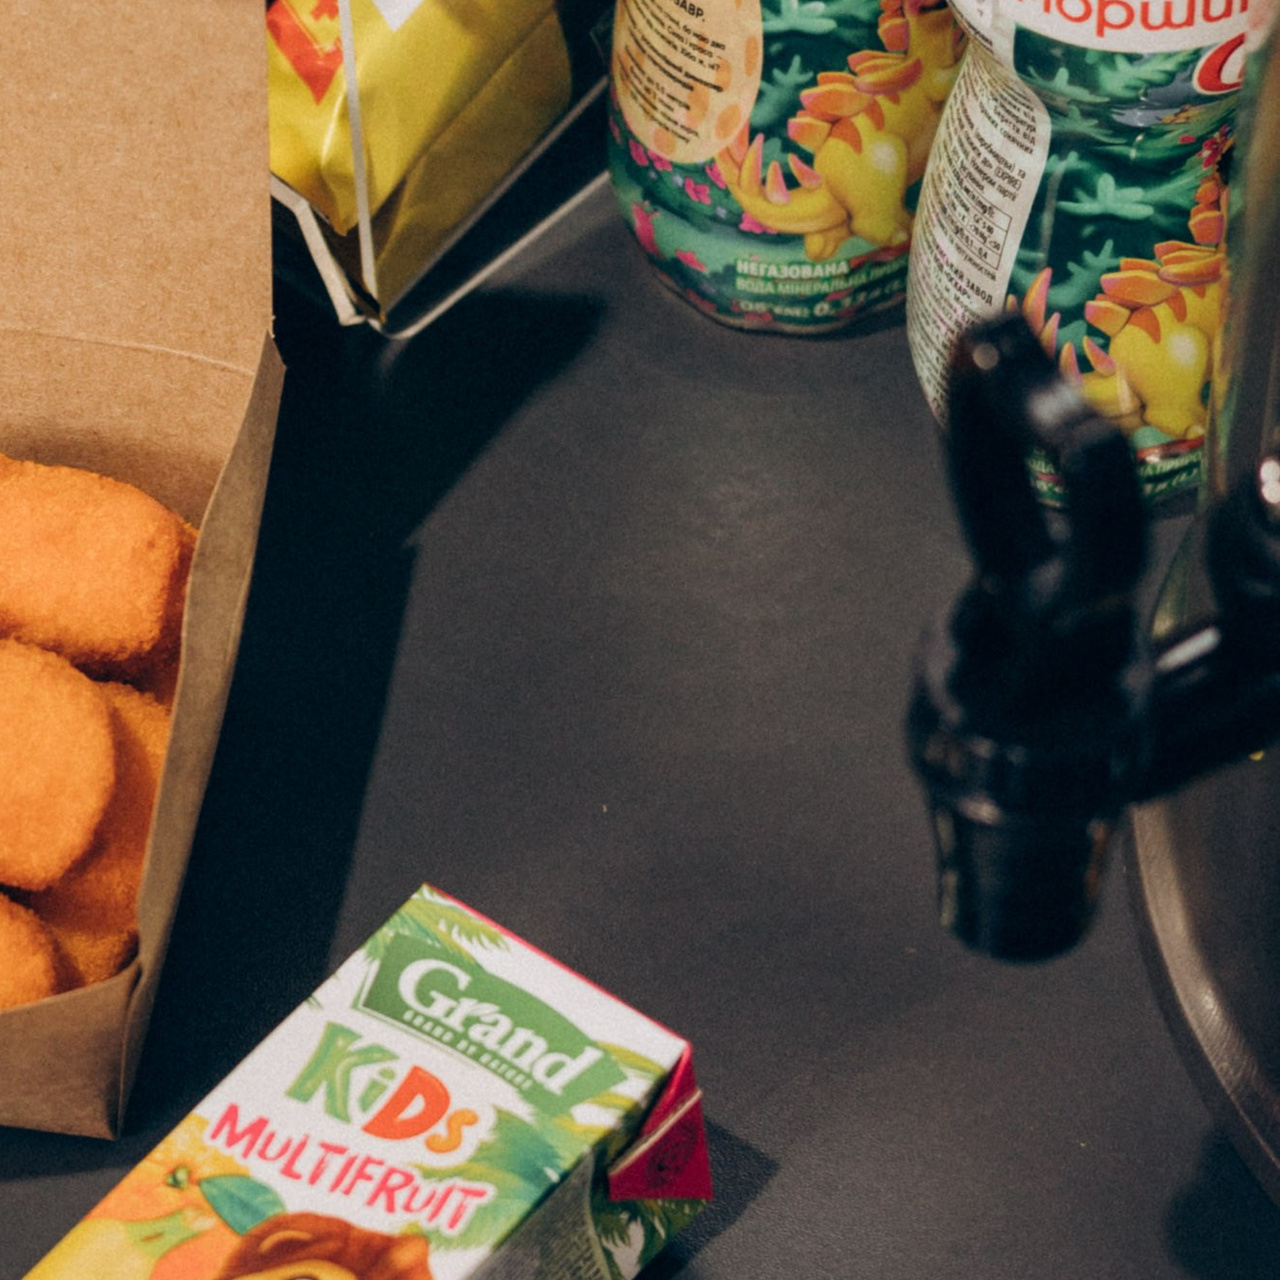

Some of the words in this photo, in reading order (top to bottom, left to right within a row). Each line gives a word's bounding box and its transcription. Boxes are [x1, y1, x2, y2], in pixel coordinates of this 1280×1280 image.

[735, 258, 850, 280] НЕГАЗОВАНА
[966, 275, 994, 306] ЗАВОД
[396, 958, 595, 1097] Grand
[402, 1010, 453, 1048] GRAND
